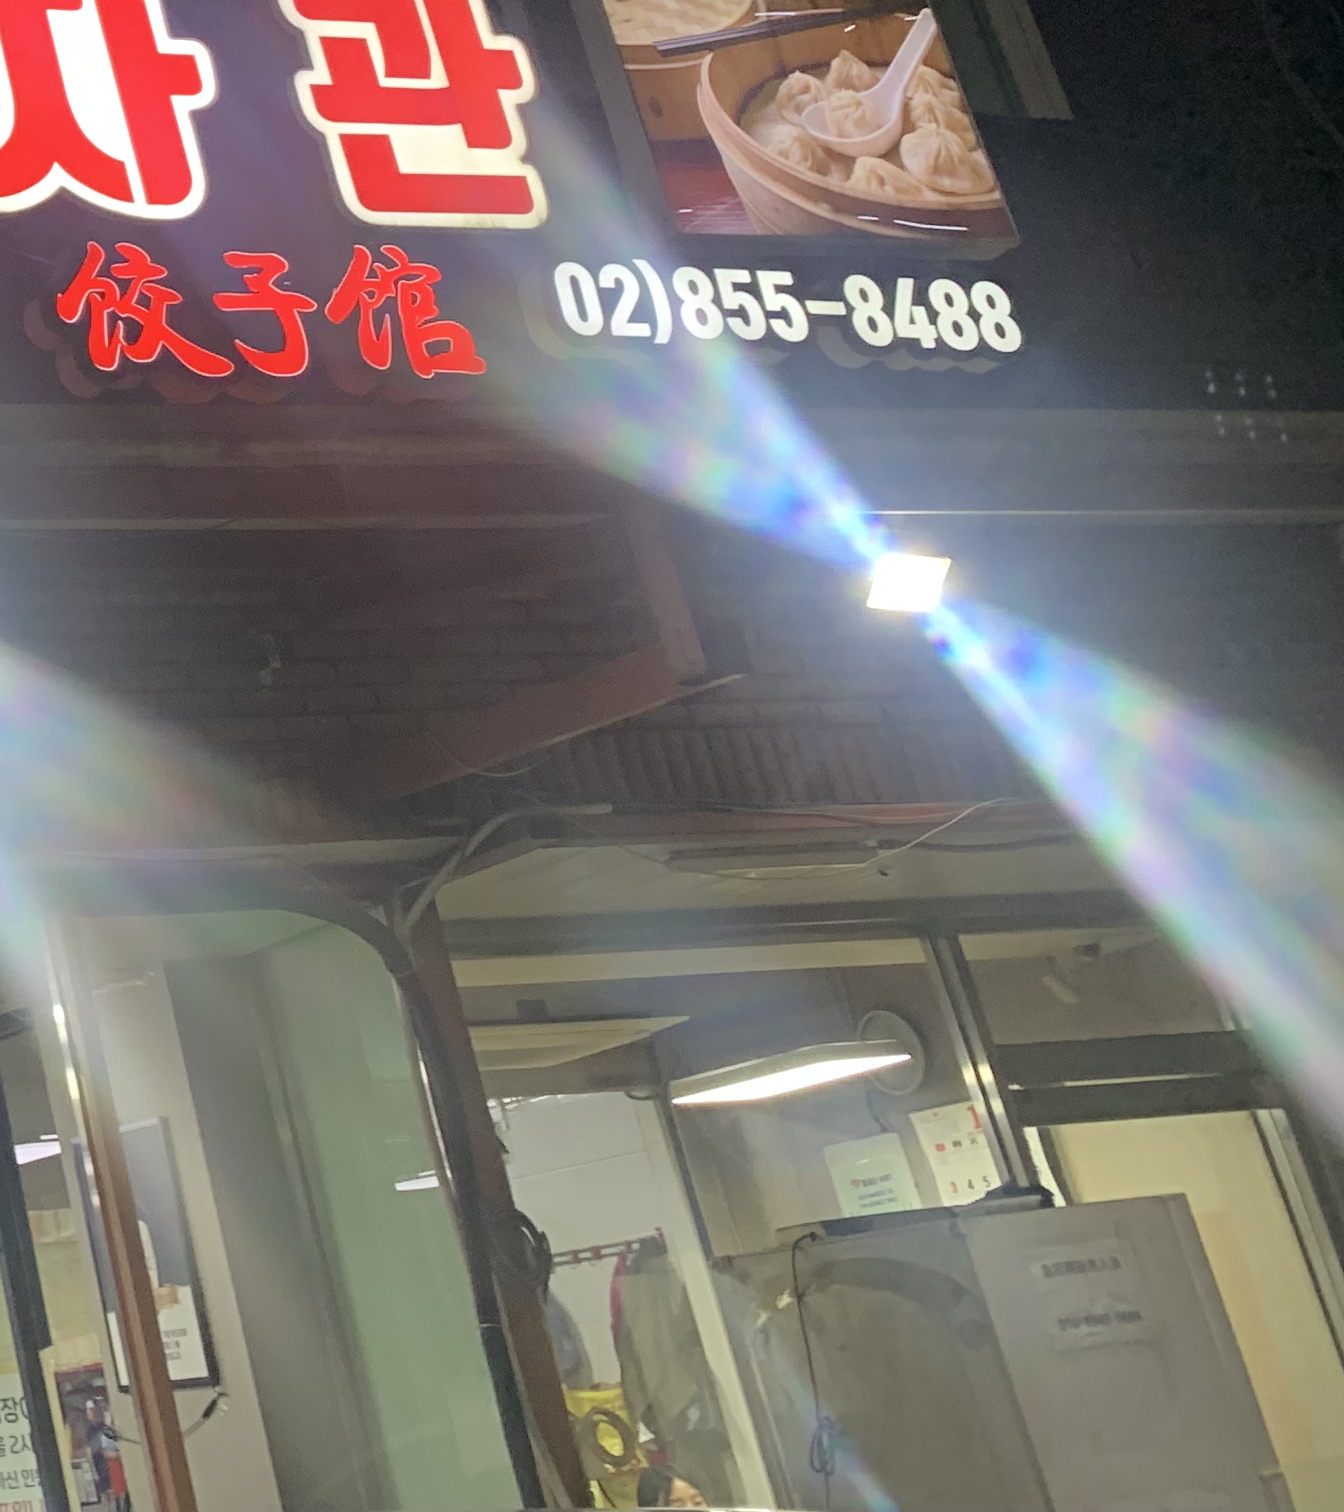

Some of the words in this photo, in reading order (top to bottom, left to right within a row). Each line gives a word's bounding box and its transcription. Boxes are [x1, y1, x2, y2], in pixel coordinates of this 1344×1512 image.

[54, 240, 487, 378] 饺子馆
[552, 260, 1025, 355] 02)855-8488
